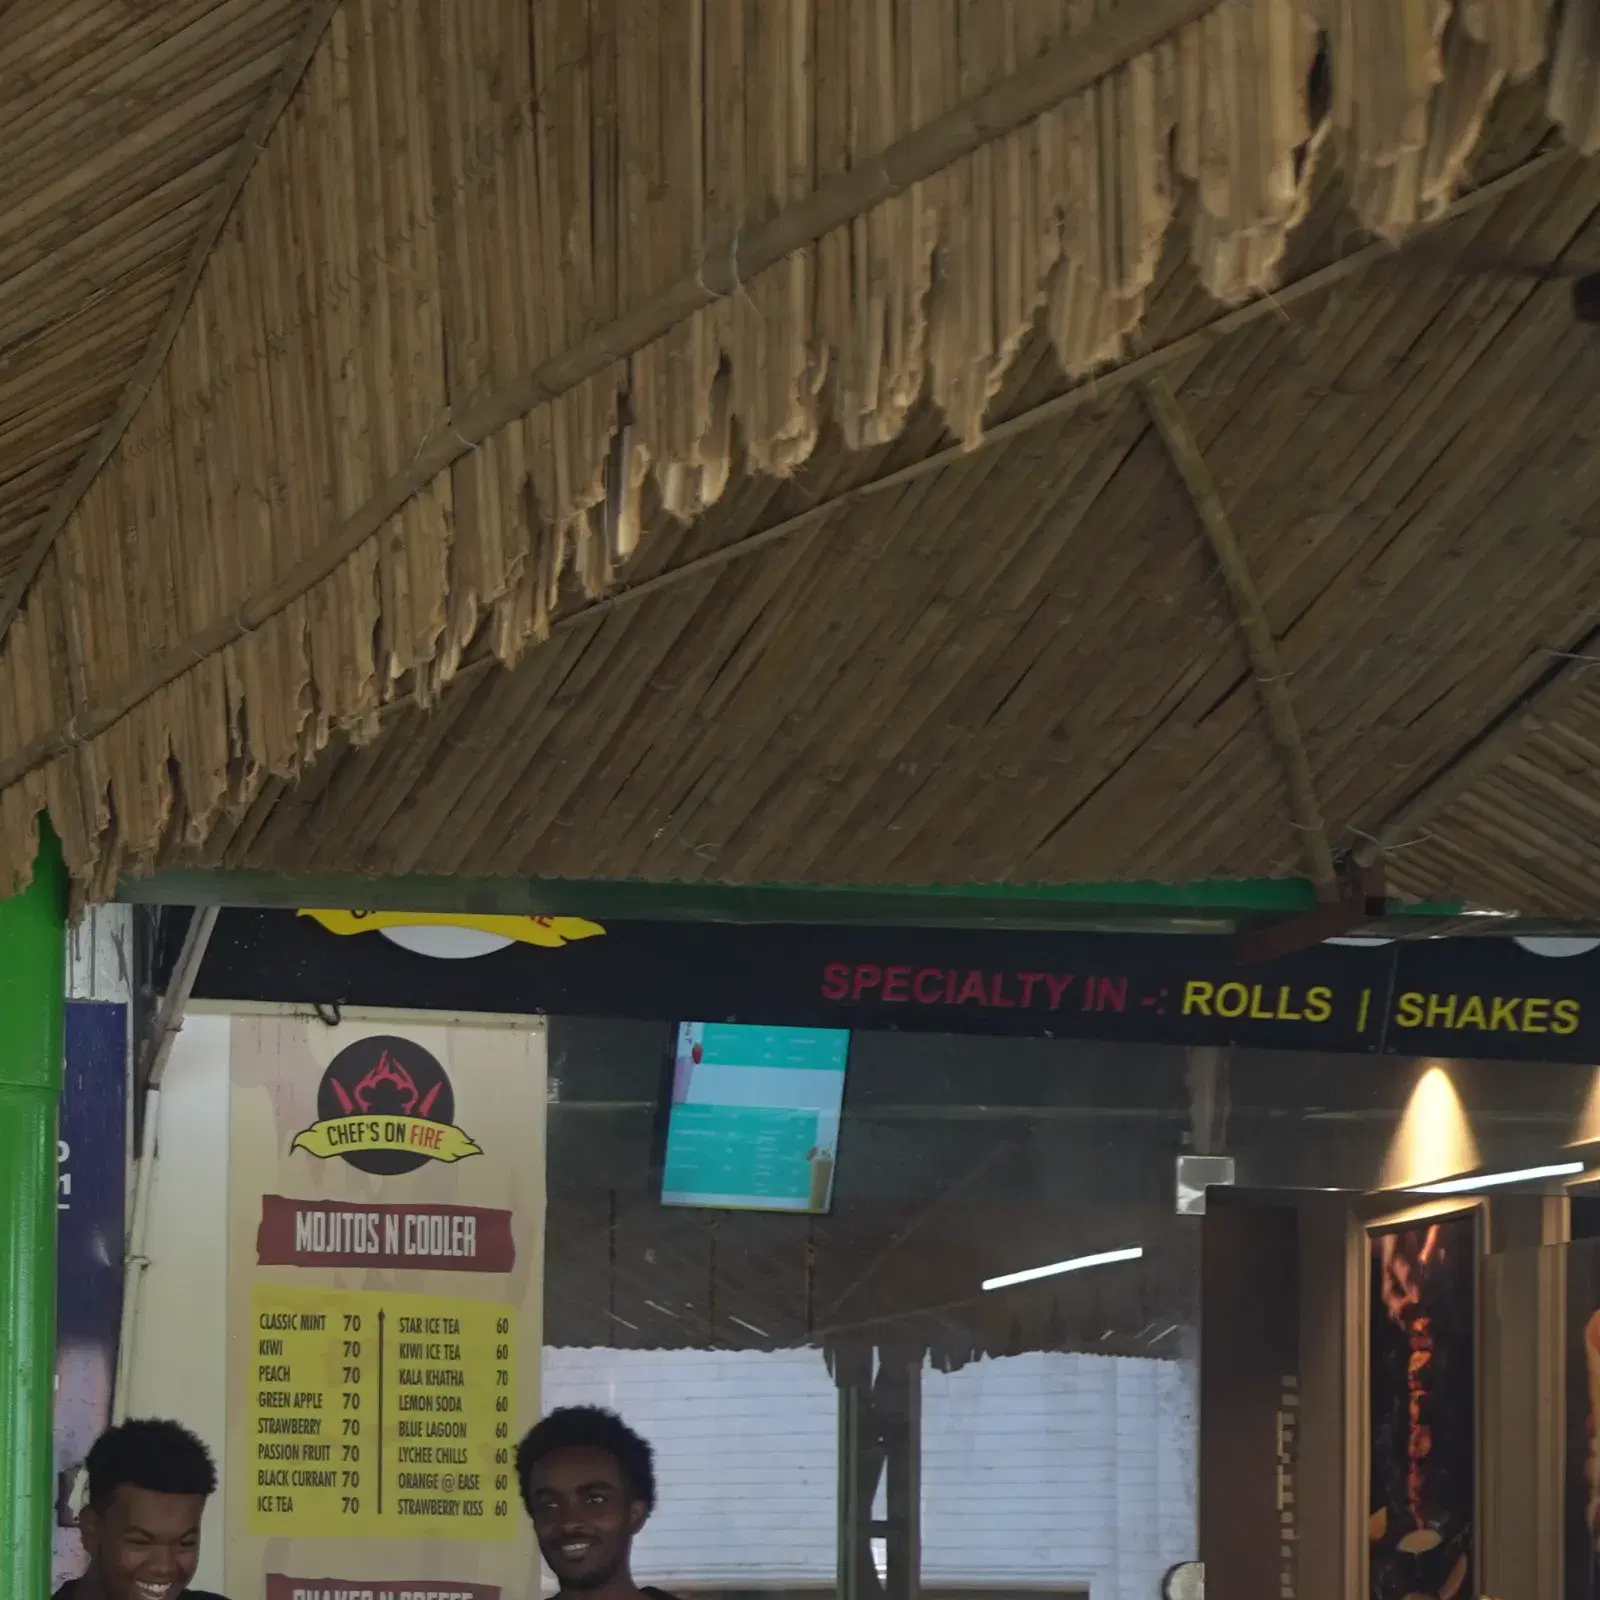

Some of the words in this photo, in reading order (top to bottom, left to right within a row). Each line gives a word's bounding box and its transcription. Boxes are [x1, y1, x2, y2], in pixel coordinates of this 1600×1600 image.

[820, 961, 1075, 1010] SPECIALTY
[1081, 976, 1128, 1013] IN
[1181, 980, 1333, 1023] ROLLS
[1394, 991, 1581, 1035] SHAKES
[326, 1121, 380, 1147] CHEF'S
[384, 1122, 406, 1143] ON
[410, 1124, 446, 1151] FIRE
[295, 1211, 380, 1254] MOJITOS
[385, 1213, 400, 1254] N
[404, 1214, 477, 1257] COOLER
[259, 1313, 298, 1331] CLASSIC
[300, 1314, 327, 1331] MINT
[343, 1314, 361, 1332] 70
[398, 1316, 423, 1334] STAR
[425, 1317, 441, 1334] ICE
[442, 1318, 460, 1335] TEA
[496, 1318, 509, 1335] 60
[259, 1339, 283, 1356] KIWI
[343, 1340, 361, 1358] 70
[399, 1343, 424, 1360] KIWI
[426, 1343, 442, 1360] ICE
[443, 1344, 461, 1361] TEA
[496, 1344, 509, 1361] 60
[259, 1365, 291, 1382] PEACH
[343, 1366, 360, 1384] 70
[399, 1368, 423, 1385] KALA
[425, 1369, 465, 1387] KHATHA
[496, 1369, 509, 1387] 70
[258, 1391, 291, 1408] GREEN
[293, 1392, 323, 1409] APPLE
[342, 1392, 360, 1410] 70
[398, 1394, 433, 1412] LEMON
[435, 1395, 462, 1413] SODA
[496, 1396, 508, 1413] 60
[257, 1417, 322, 1435] STRAWBERRY
[342, 1418, 360, 1436] 70
[398, 1420, 423, 1438] BLUE
[426, 1421, 467, 1438] LAGOON
[496, 1422, 508, 1439] 60
[258, 1444, 300, 1461] PASSION
[302, 1444, 331, 1461] FRUIT
[342, 1444, 360, 1462] 70
[398, 1446, 433, 1464] LYCHEE
[435, 1447, 468, 1465] CHILLS
[495, 1448, 508, 1465] 60
[257, 1469, 290, 1487] BLACK
[292, 1470, 337, 1487] CURRANT
[342, 1470, 359, 1488] 70
[398, 1472, 439, 1490] ORANGE
[441, 1473, 455, 1493] @
[457, 1474, 481, 1491] EASE
[495, 1474, 508, 1491] 60
[257, 1496, 272, 1512] ICE
[274, 1497, 293, 1513] TEA
[341, 1497, 359, 1514] 70
[398, 1498, 461, 1516] STRAWBERRY
[463, 1499, 484, 1517] KISS
[495, 1500, 508, 1517] 60
